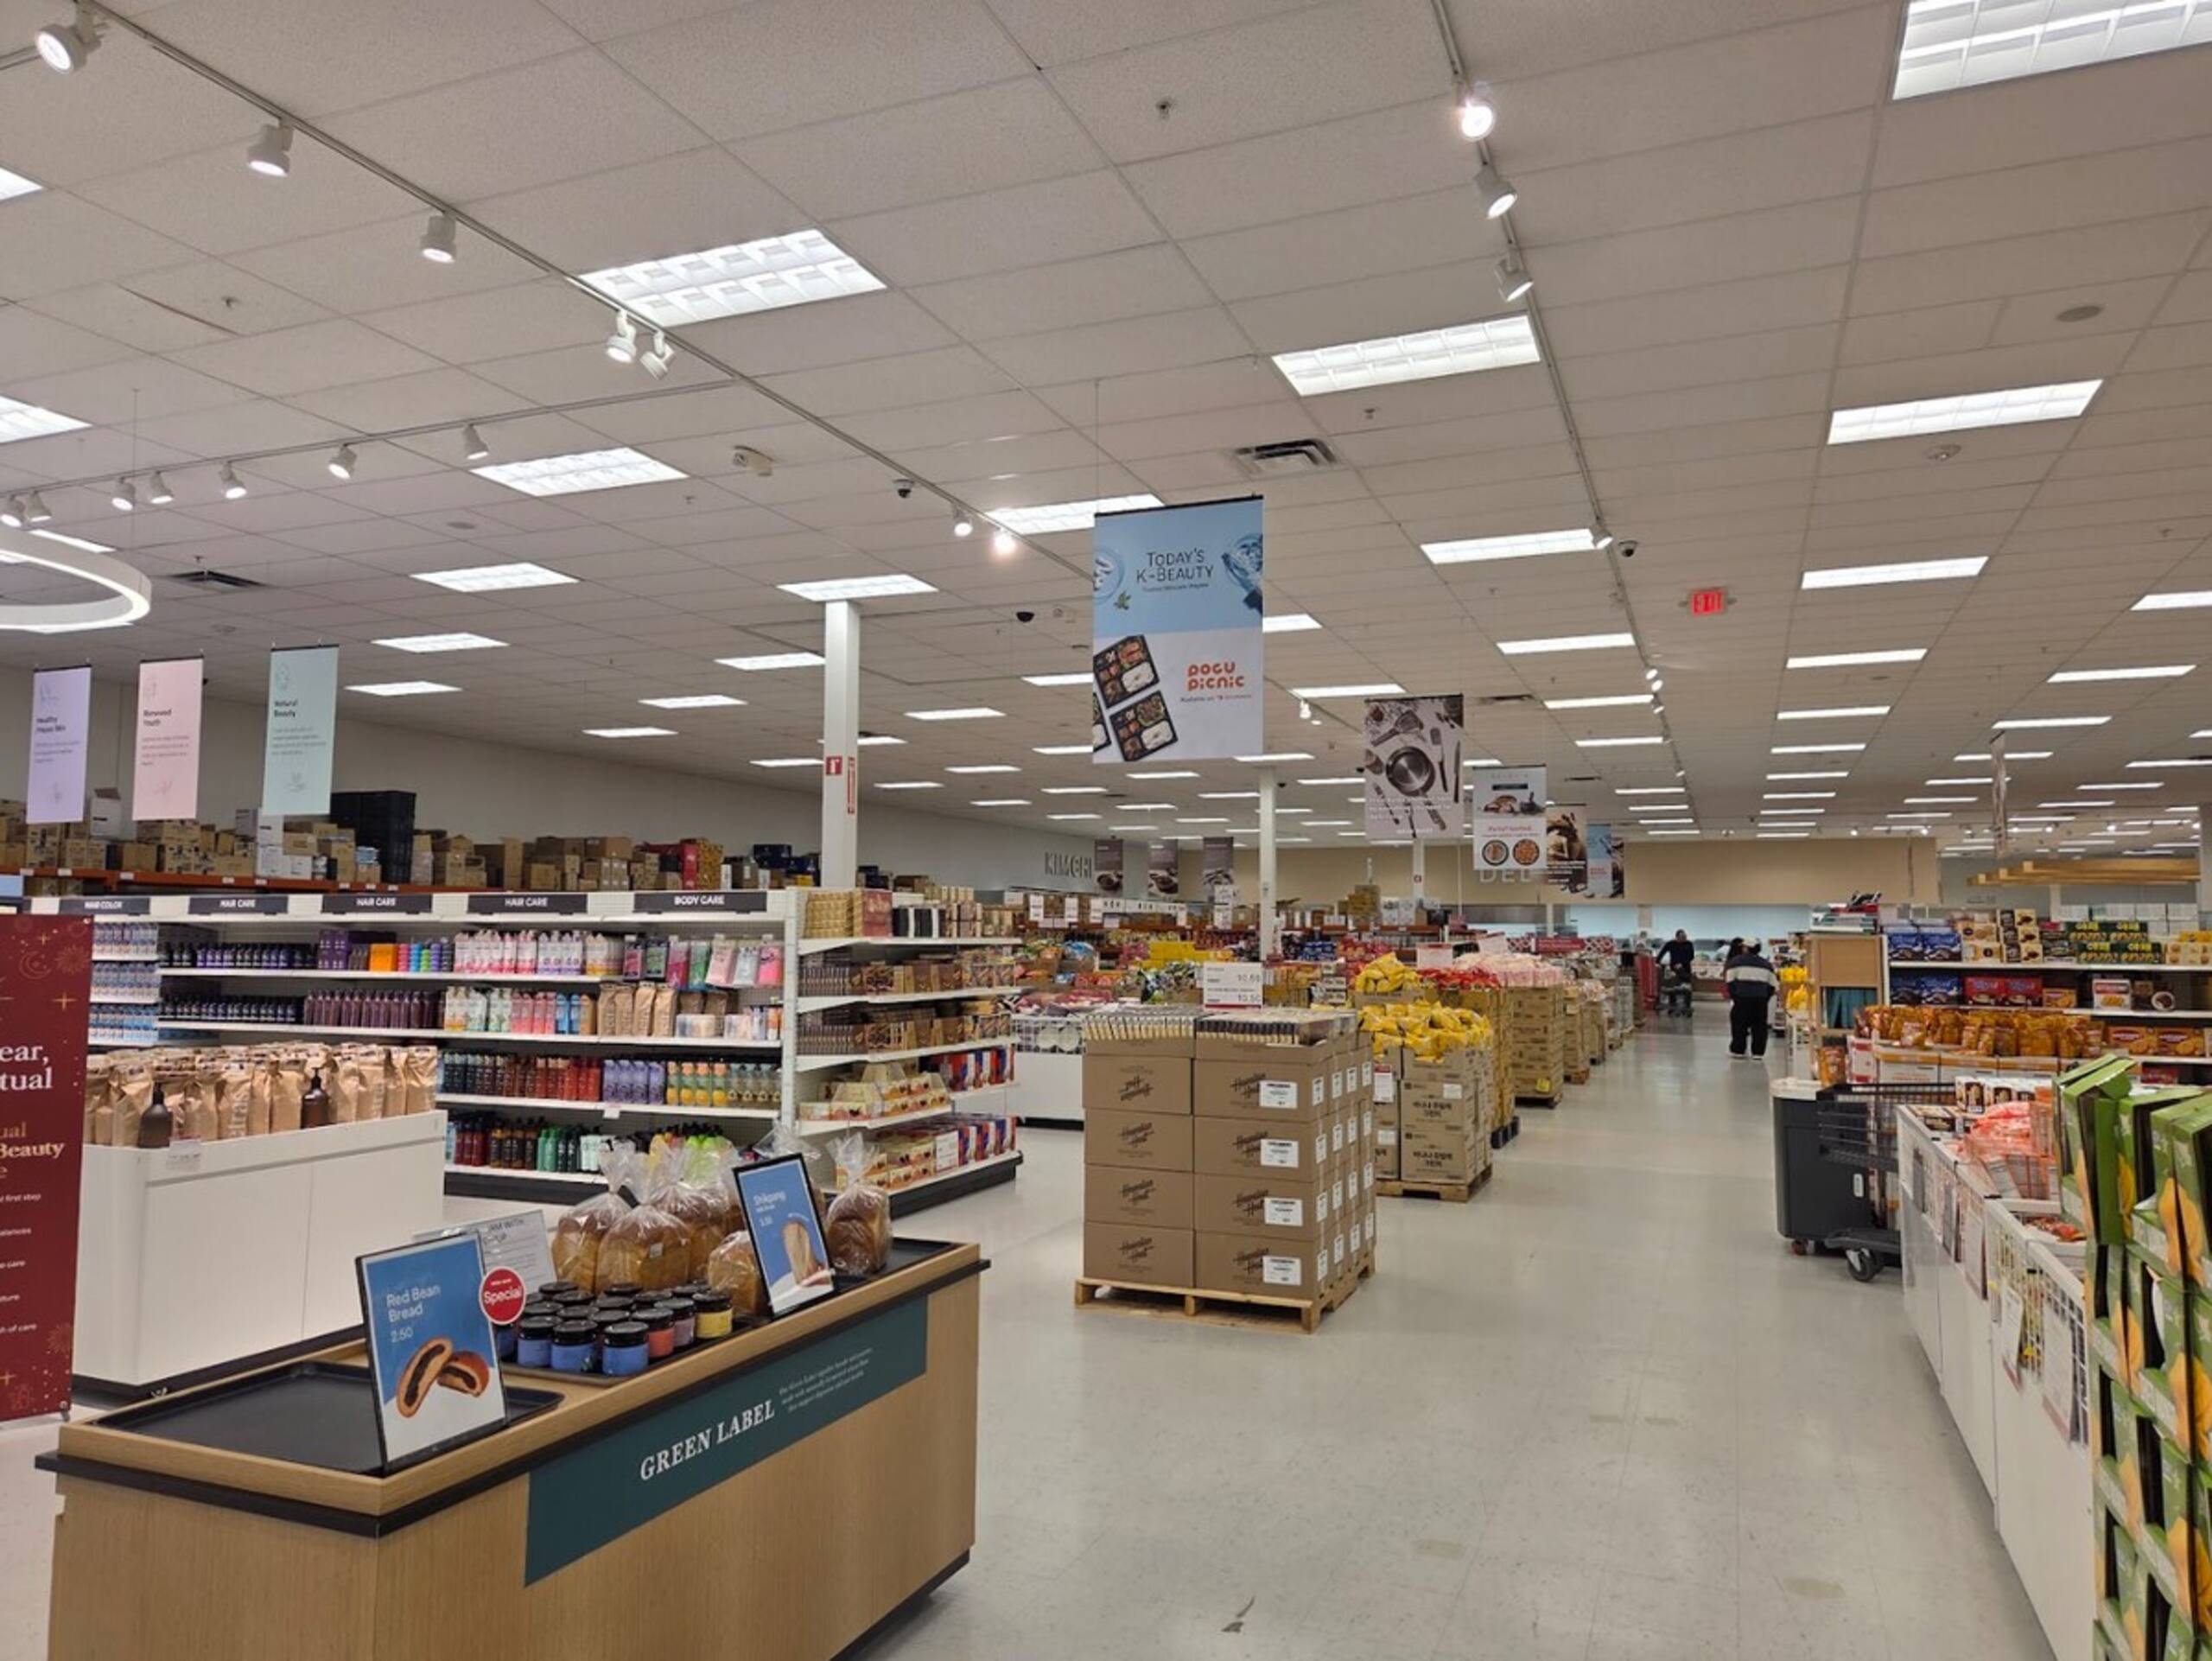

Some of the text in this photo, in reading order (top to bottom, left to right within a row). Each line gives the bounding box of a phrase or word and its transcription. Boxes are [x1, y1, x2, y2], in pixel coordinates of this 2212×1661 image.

[1147, 547, 1205, 567] TODAY'S
[1136, 565, 1214, 583] K-BEAUTY
[1188, 676, 1245, 691] picnic
[1479, 869, 1532, 883] DEL
[219, 899, 256, 909] HAIR CARE
[357, 897, 397, 907] HAIR CARE
[505, 897, 548, 907] HAIR CARE
[674, 895, 724, 906] BODY CARE
[386, 1284, 442, 1308] Red Bean
[484, 1285, 522, 1306] Special
[388, 1302, 423, 1323] Bread
[640, 1399, 775, 1481] GREEN LABEL
